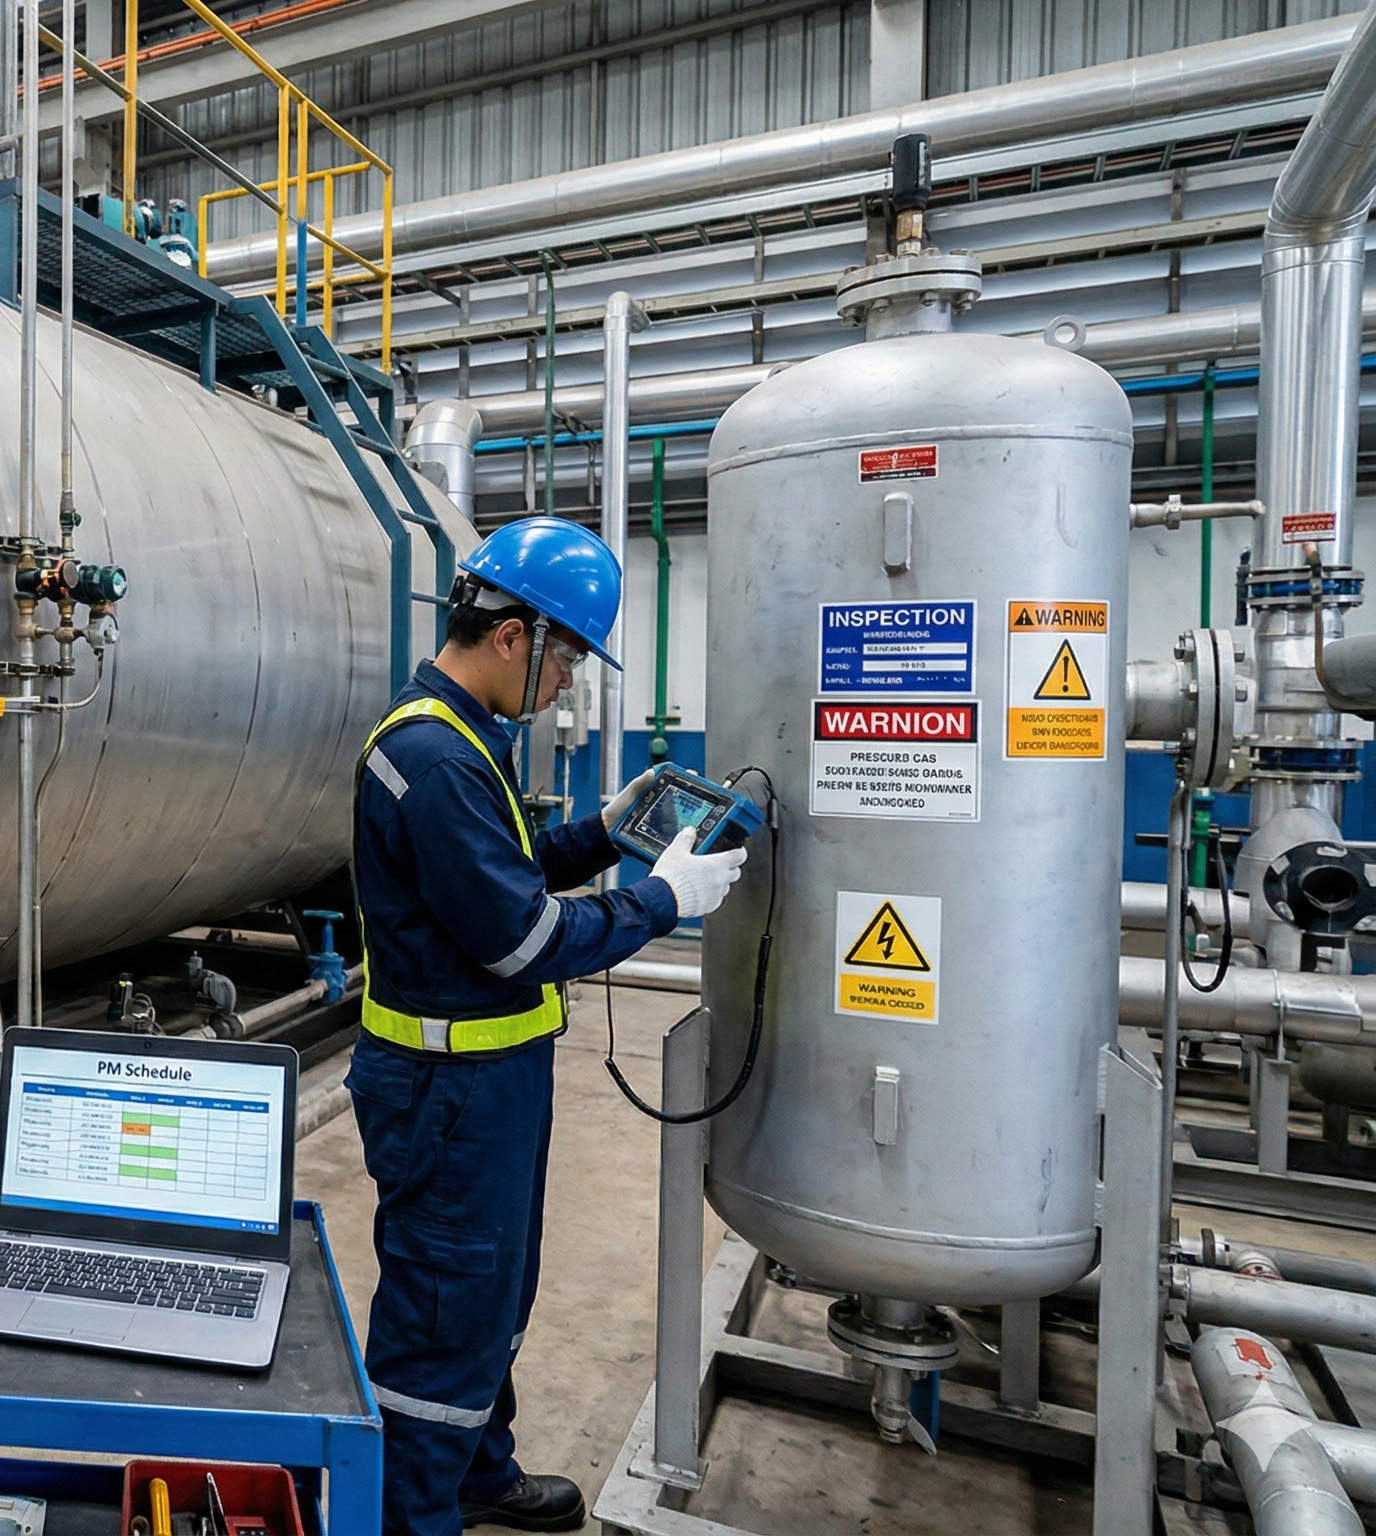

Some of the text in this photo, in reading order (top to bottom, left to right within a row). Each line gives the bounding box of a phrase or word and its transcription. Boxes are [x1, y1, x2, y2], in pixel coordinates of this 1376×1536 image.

[829, 608, 965, 628] INSPECTION
[1035, 609, 1105, 627] WARNING
[824, 711, 965, 735] WARNION
[913, 753, 937, 764] CAS
[858, 983, 916, 998] WARNING
[97, 1061, 192, 1081] PM Schedule
